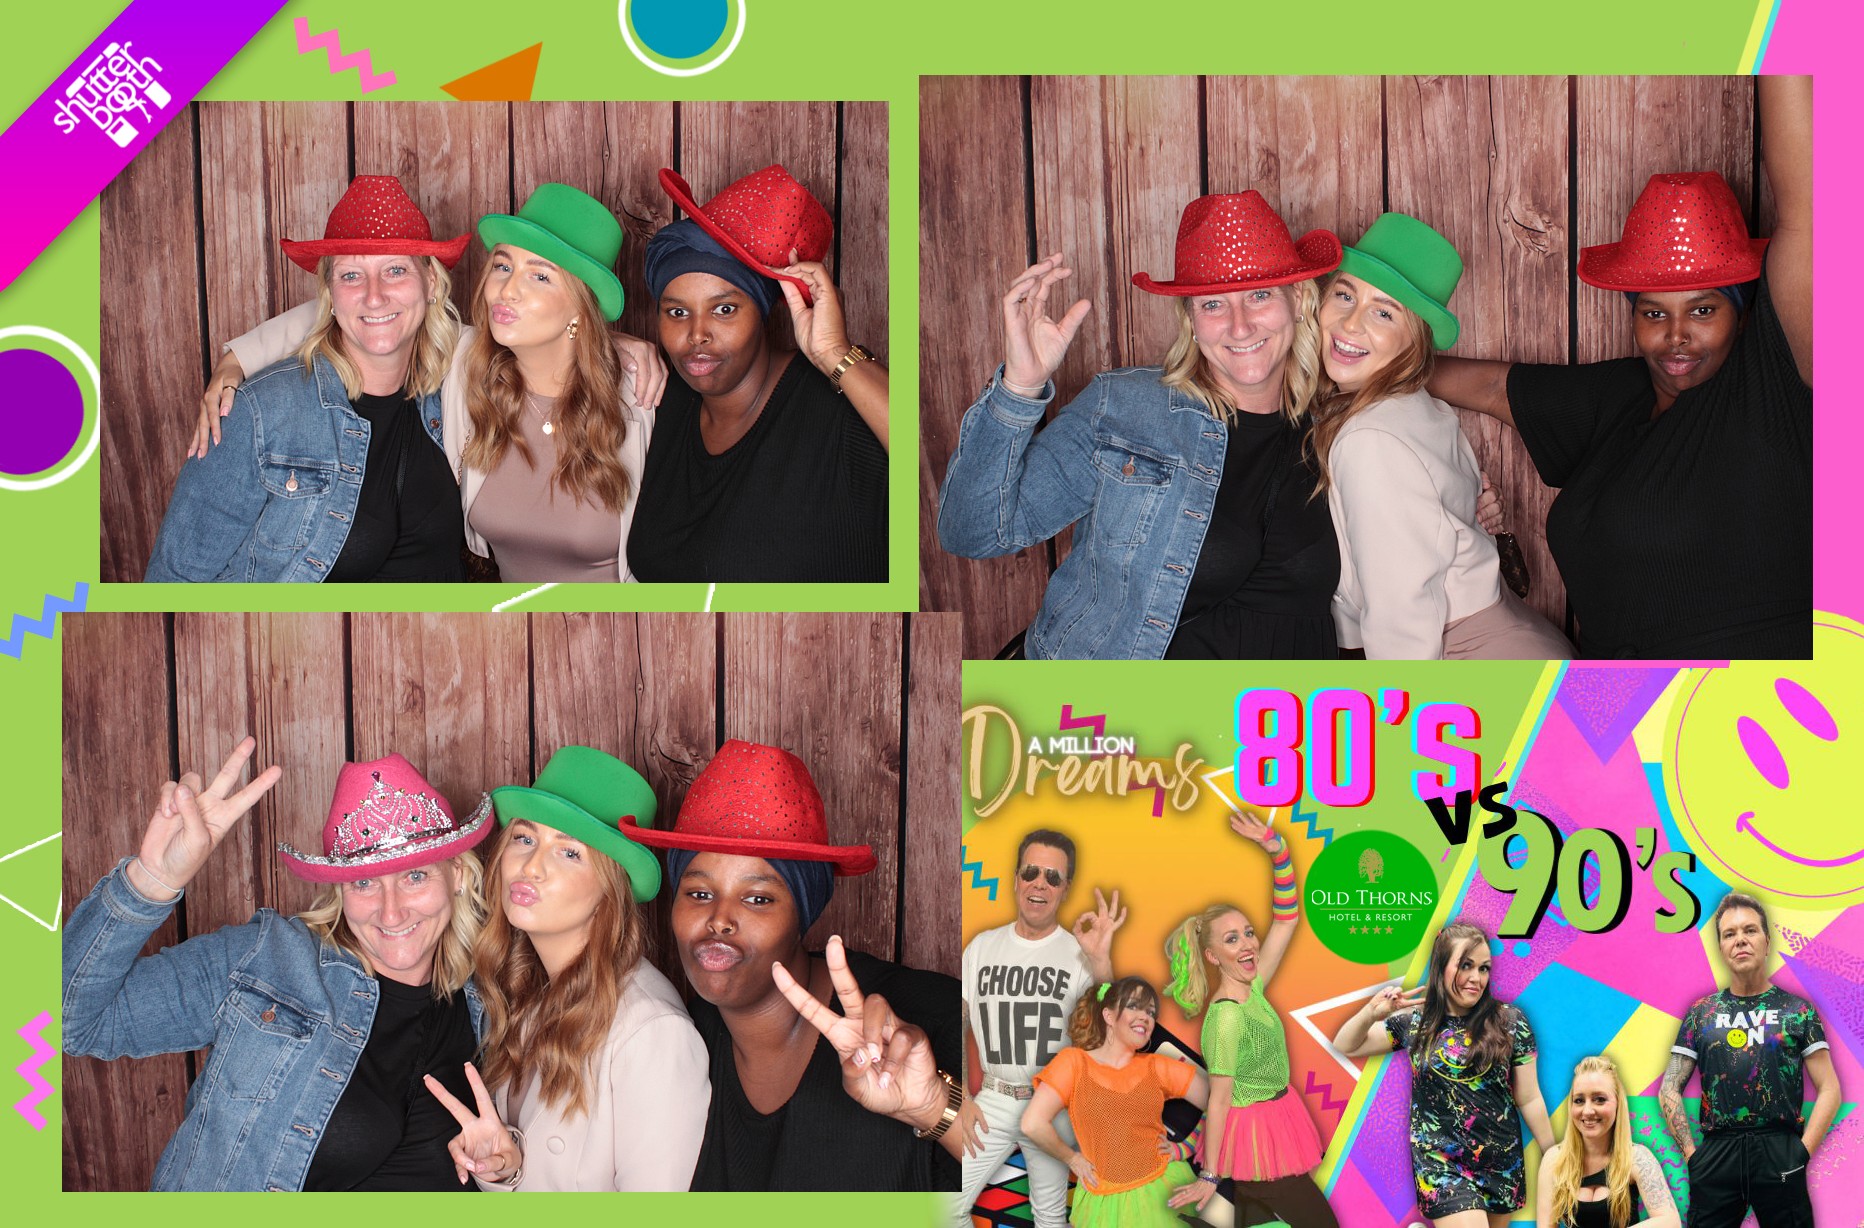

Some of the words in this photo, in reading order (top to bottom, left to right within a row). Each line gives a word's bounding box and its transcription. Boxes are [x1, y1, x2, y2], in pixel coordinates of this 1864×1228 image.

[977, 965, 1072, 1000] CHOOSE
[979, 1001, 1068, 1066] LIFE
[1715, 1009, 1780, 1029] RAVE
